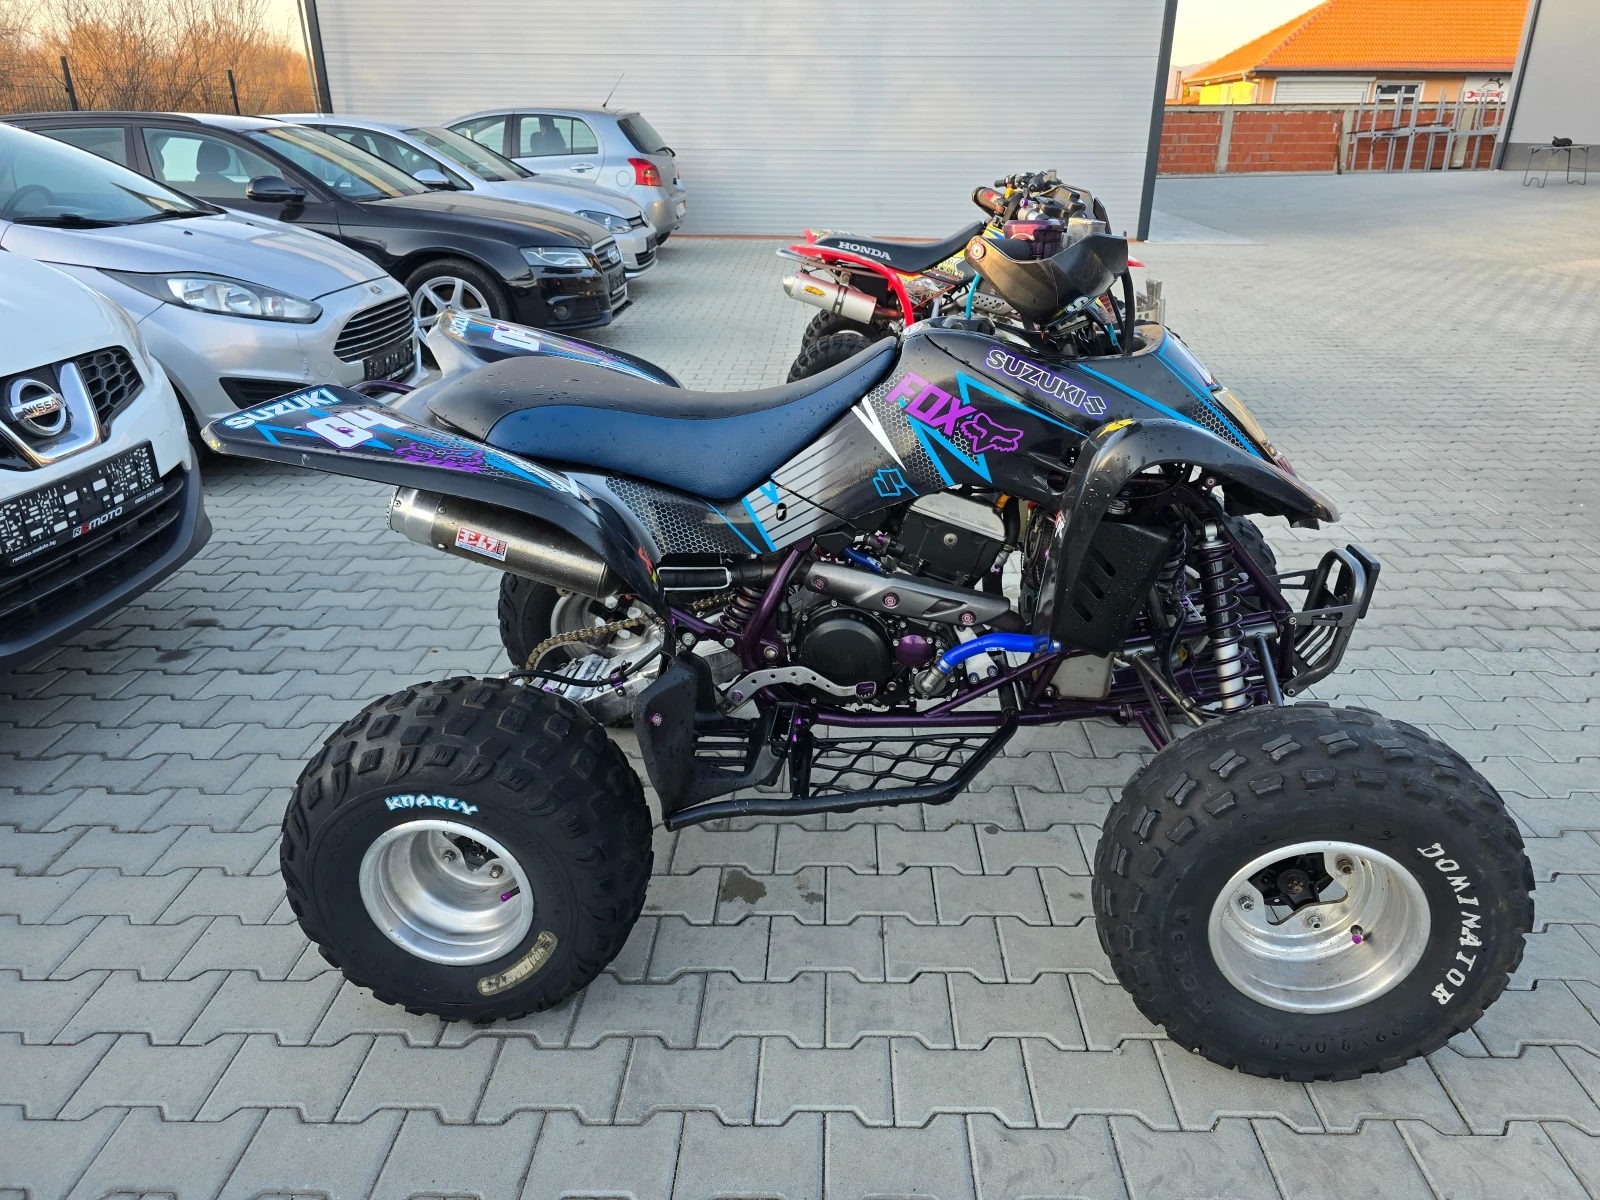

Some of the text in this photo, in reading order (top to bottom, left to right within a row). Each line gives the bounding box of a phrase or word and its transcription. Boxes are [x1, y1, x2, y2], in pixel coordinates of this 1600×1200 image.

[838, 241, 892, 261] HONDA
[985, 349, 1087, 408] SUZUKI
[22, 397, 64, 416] NISSAN
[222, 387, 342, 430] SUZUKI
[884, 371, 977, 437] FOX
[384, 793, 479, 816] KNARLY
[1416, 842, 1483, 1006] DOMINATOR
